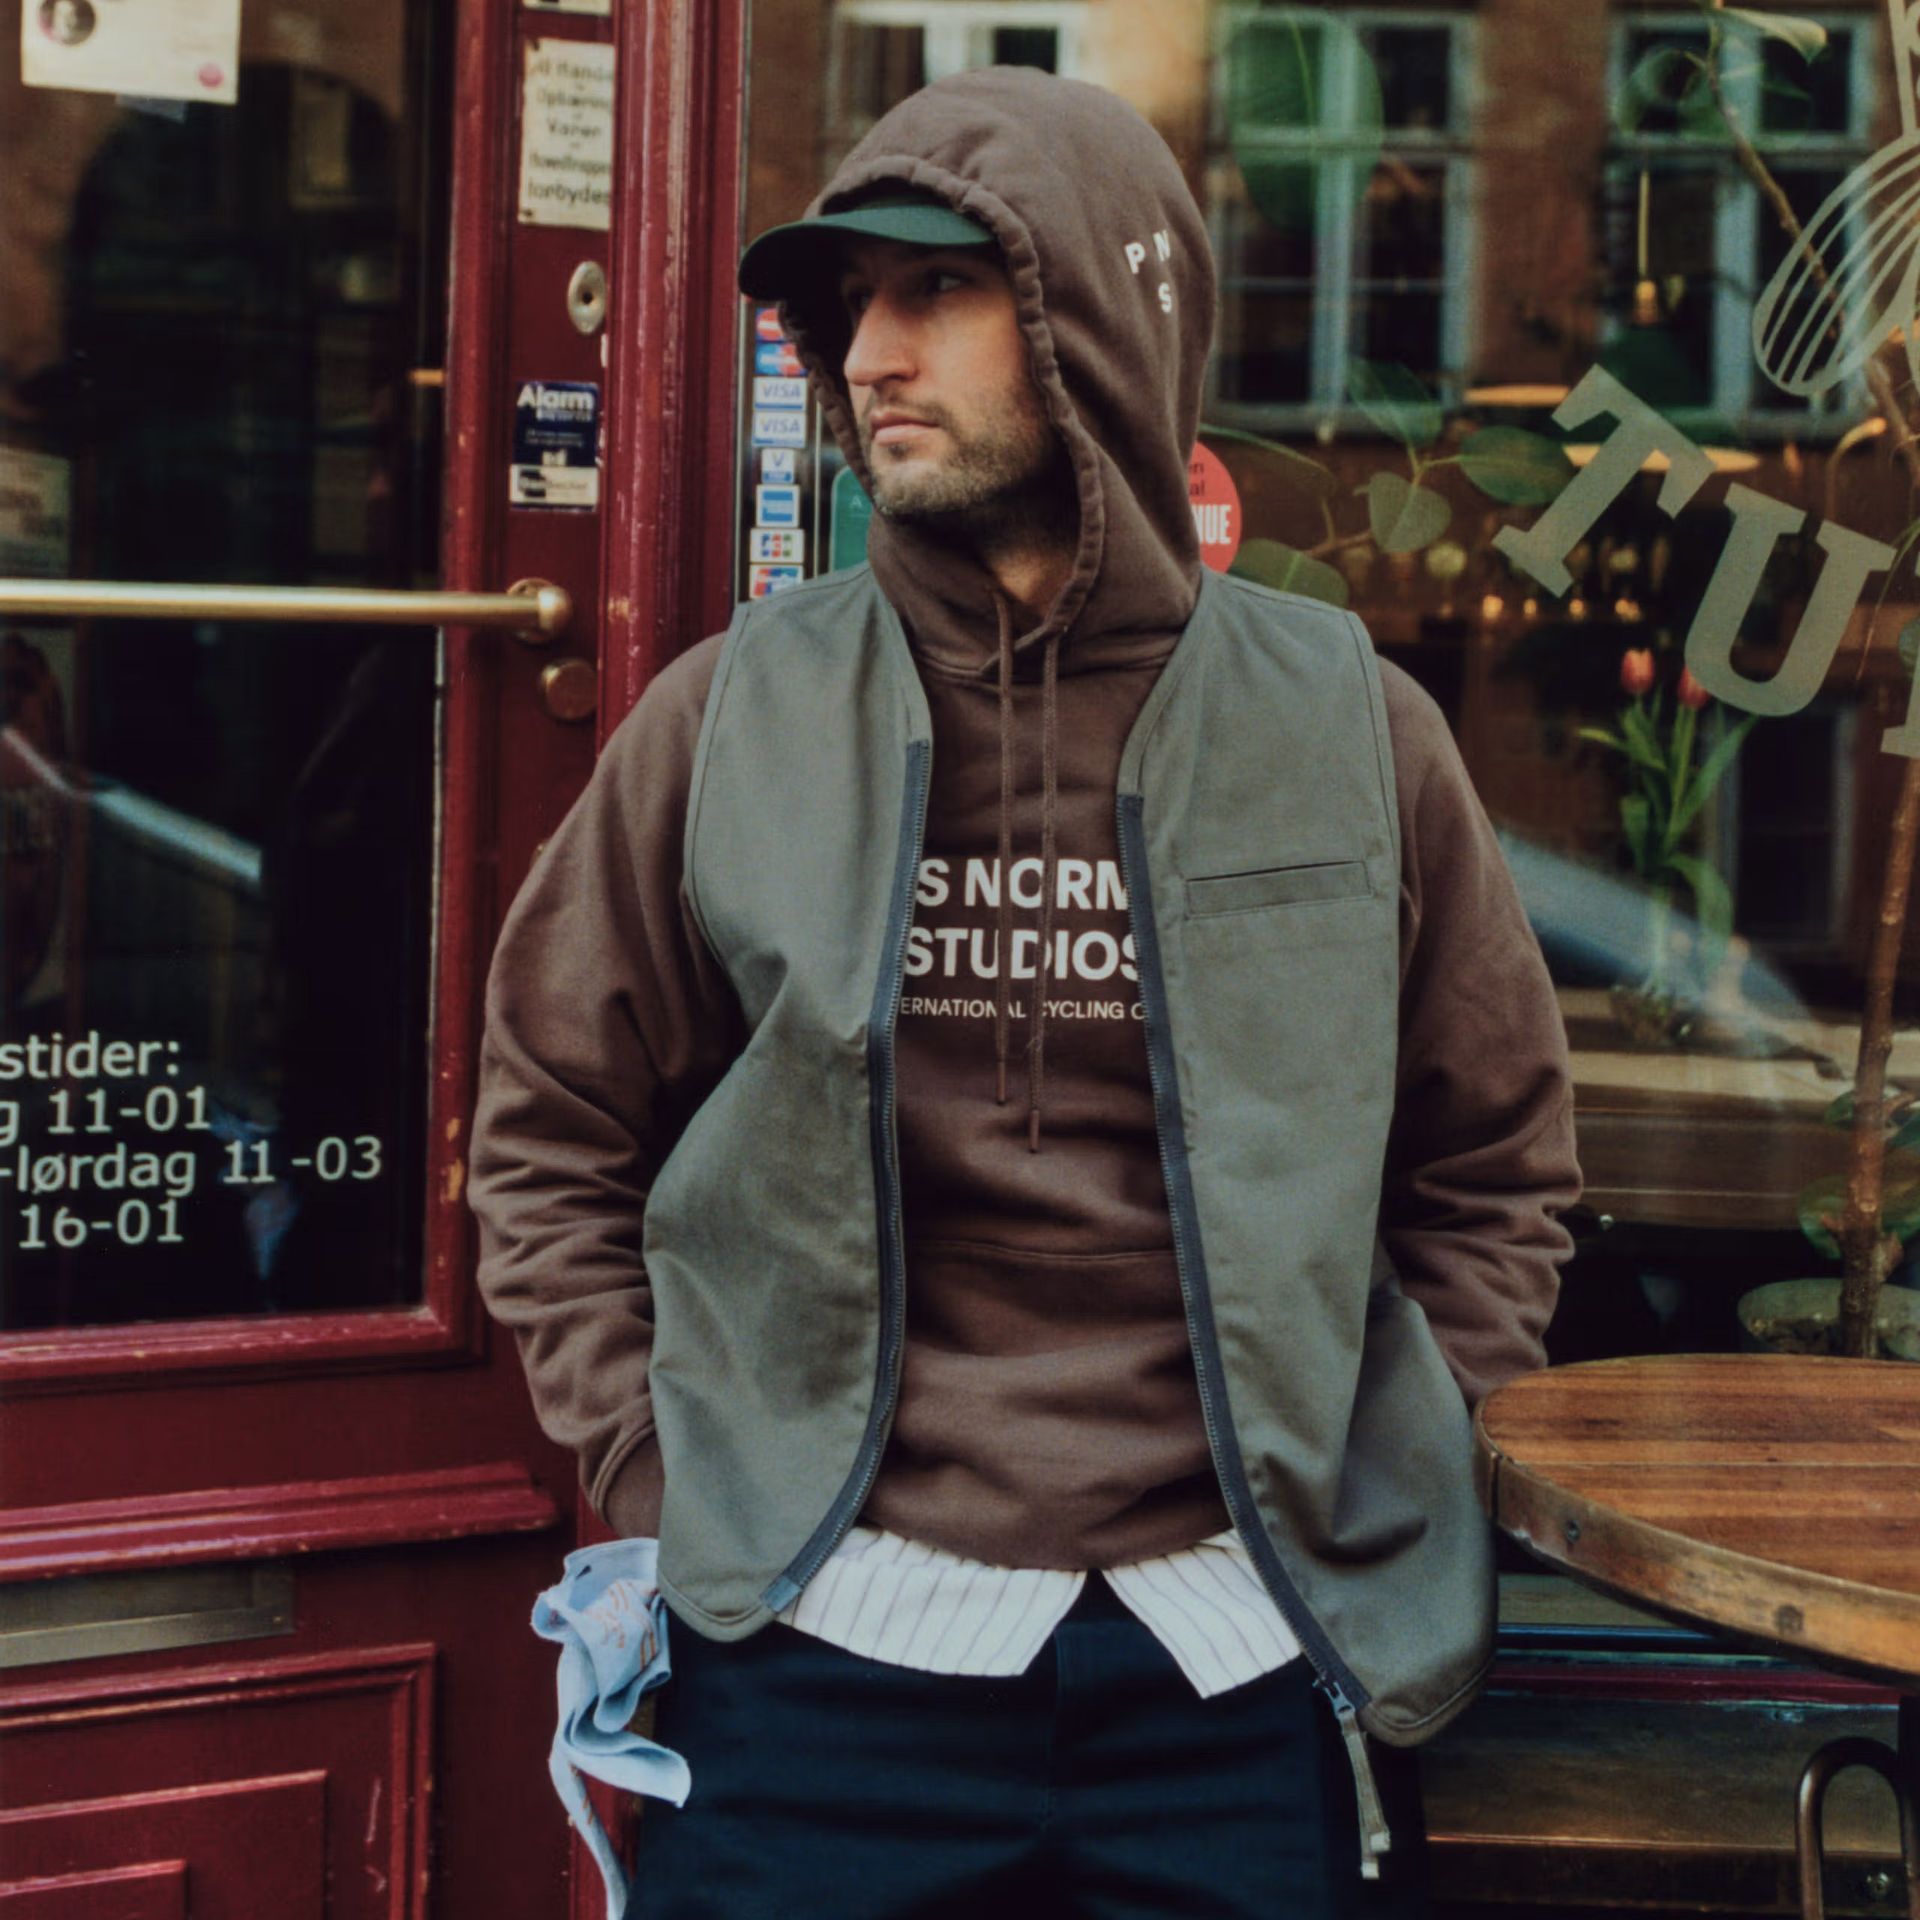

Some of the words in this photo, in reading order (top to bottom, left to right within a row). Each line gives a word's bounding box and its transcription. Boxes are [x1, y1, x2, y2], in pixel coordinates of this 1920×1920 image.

[1125, 242, 1146, 274] P
[1153, 230, 1171, 262] N
[1158, 282, 1172, 314] S
[516, 383, 595, 410] Alarm
[761, 382, 801, 398] VISA
[760, 418, 800, 433] VISA
[1041, 1001, 1125, 1021] YCLING
[0, 1030, 181, 1079] stider:
[48, 1085, 211, 1134] 11-01
[19, 1199, 184, 1249] 16-01
